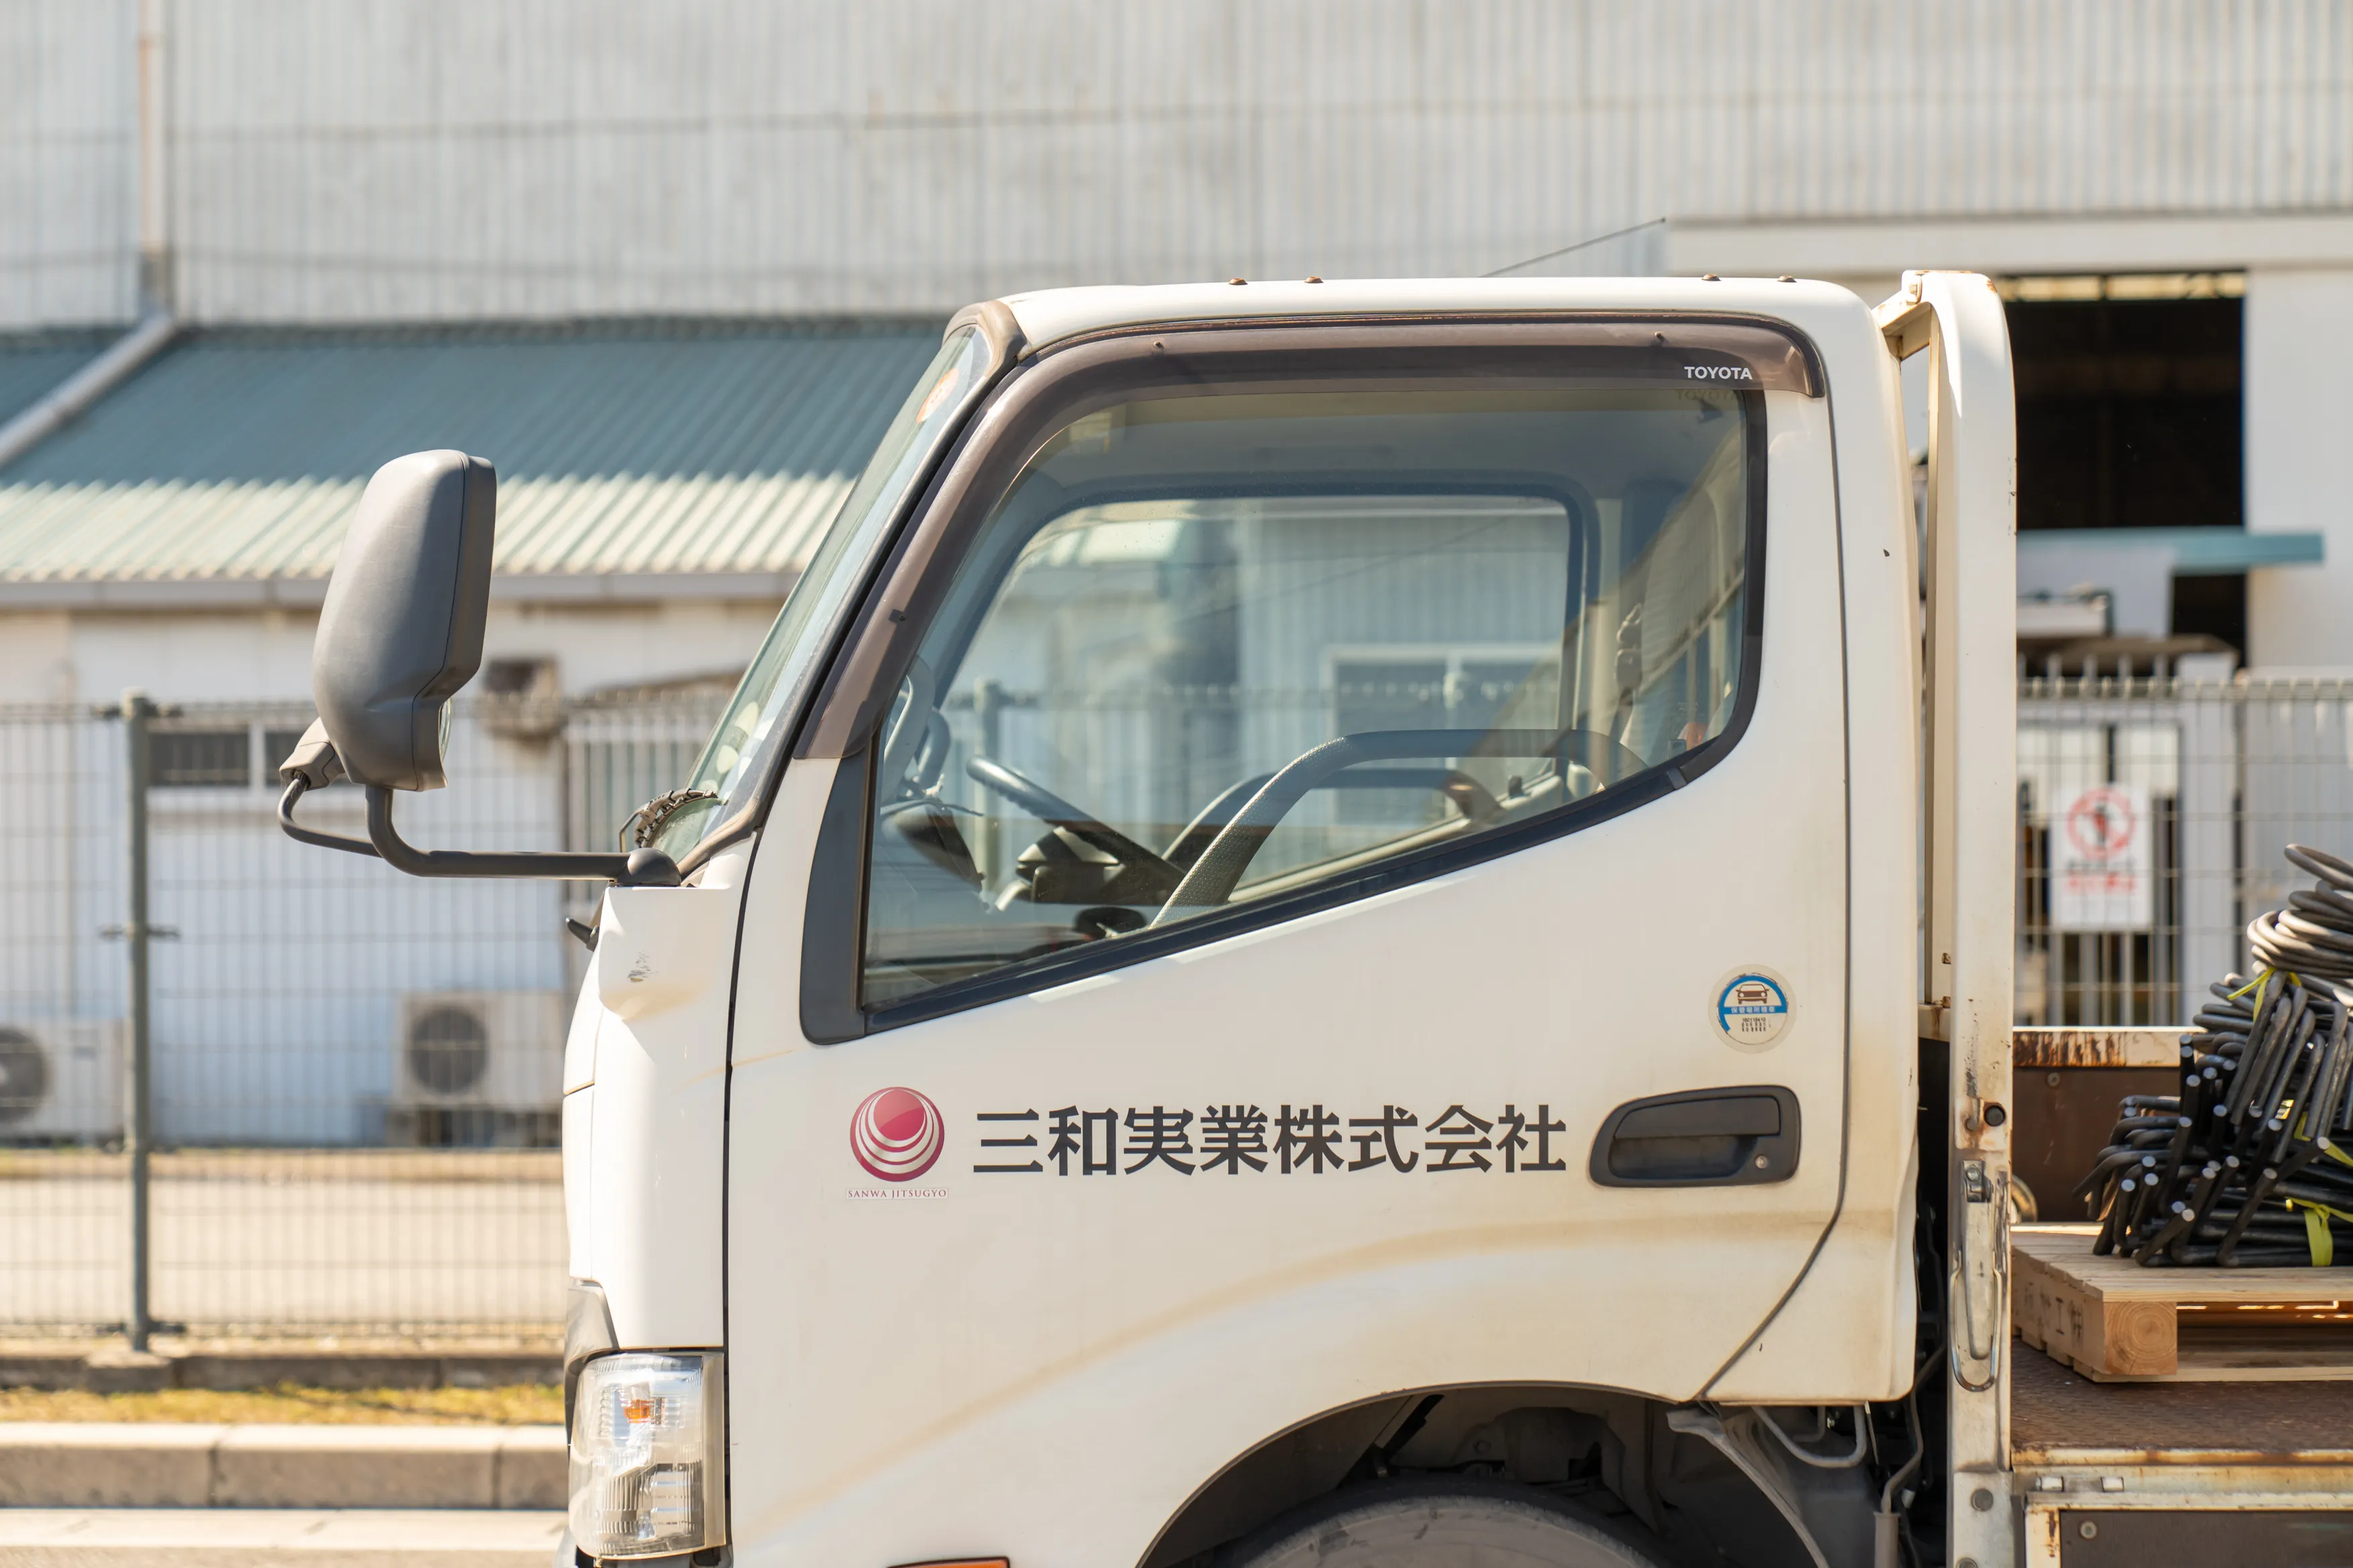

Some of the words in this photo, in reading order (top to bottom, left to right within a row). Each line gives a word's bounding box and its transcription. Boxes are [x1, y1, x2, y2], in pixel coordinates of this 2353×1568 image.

[1683, 366, 1753, 380] TOYOTA
[973, 1104, 1566, 1176] 三和実業株式会社
[848, 1190, 887, 1198] SANWA
[891, 1189, 947, 1199] JITSUGYO
